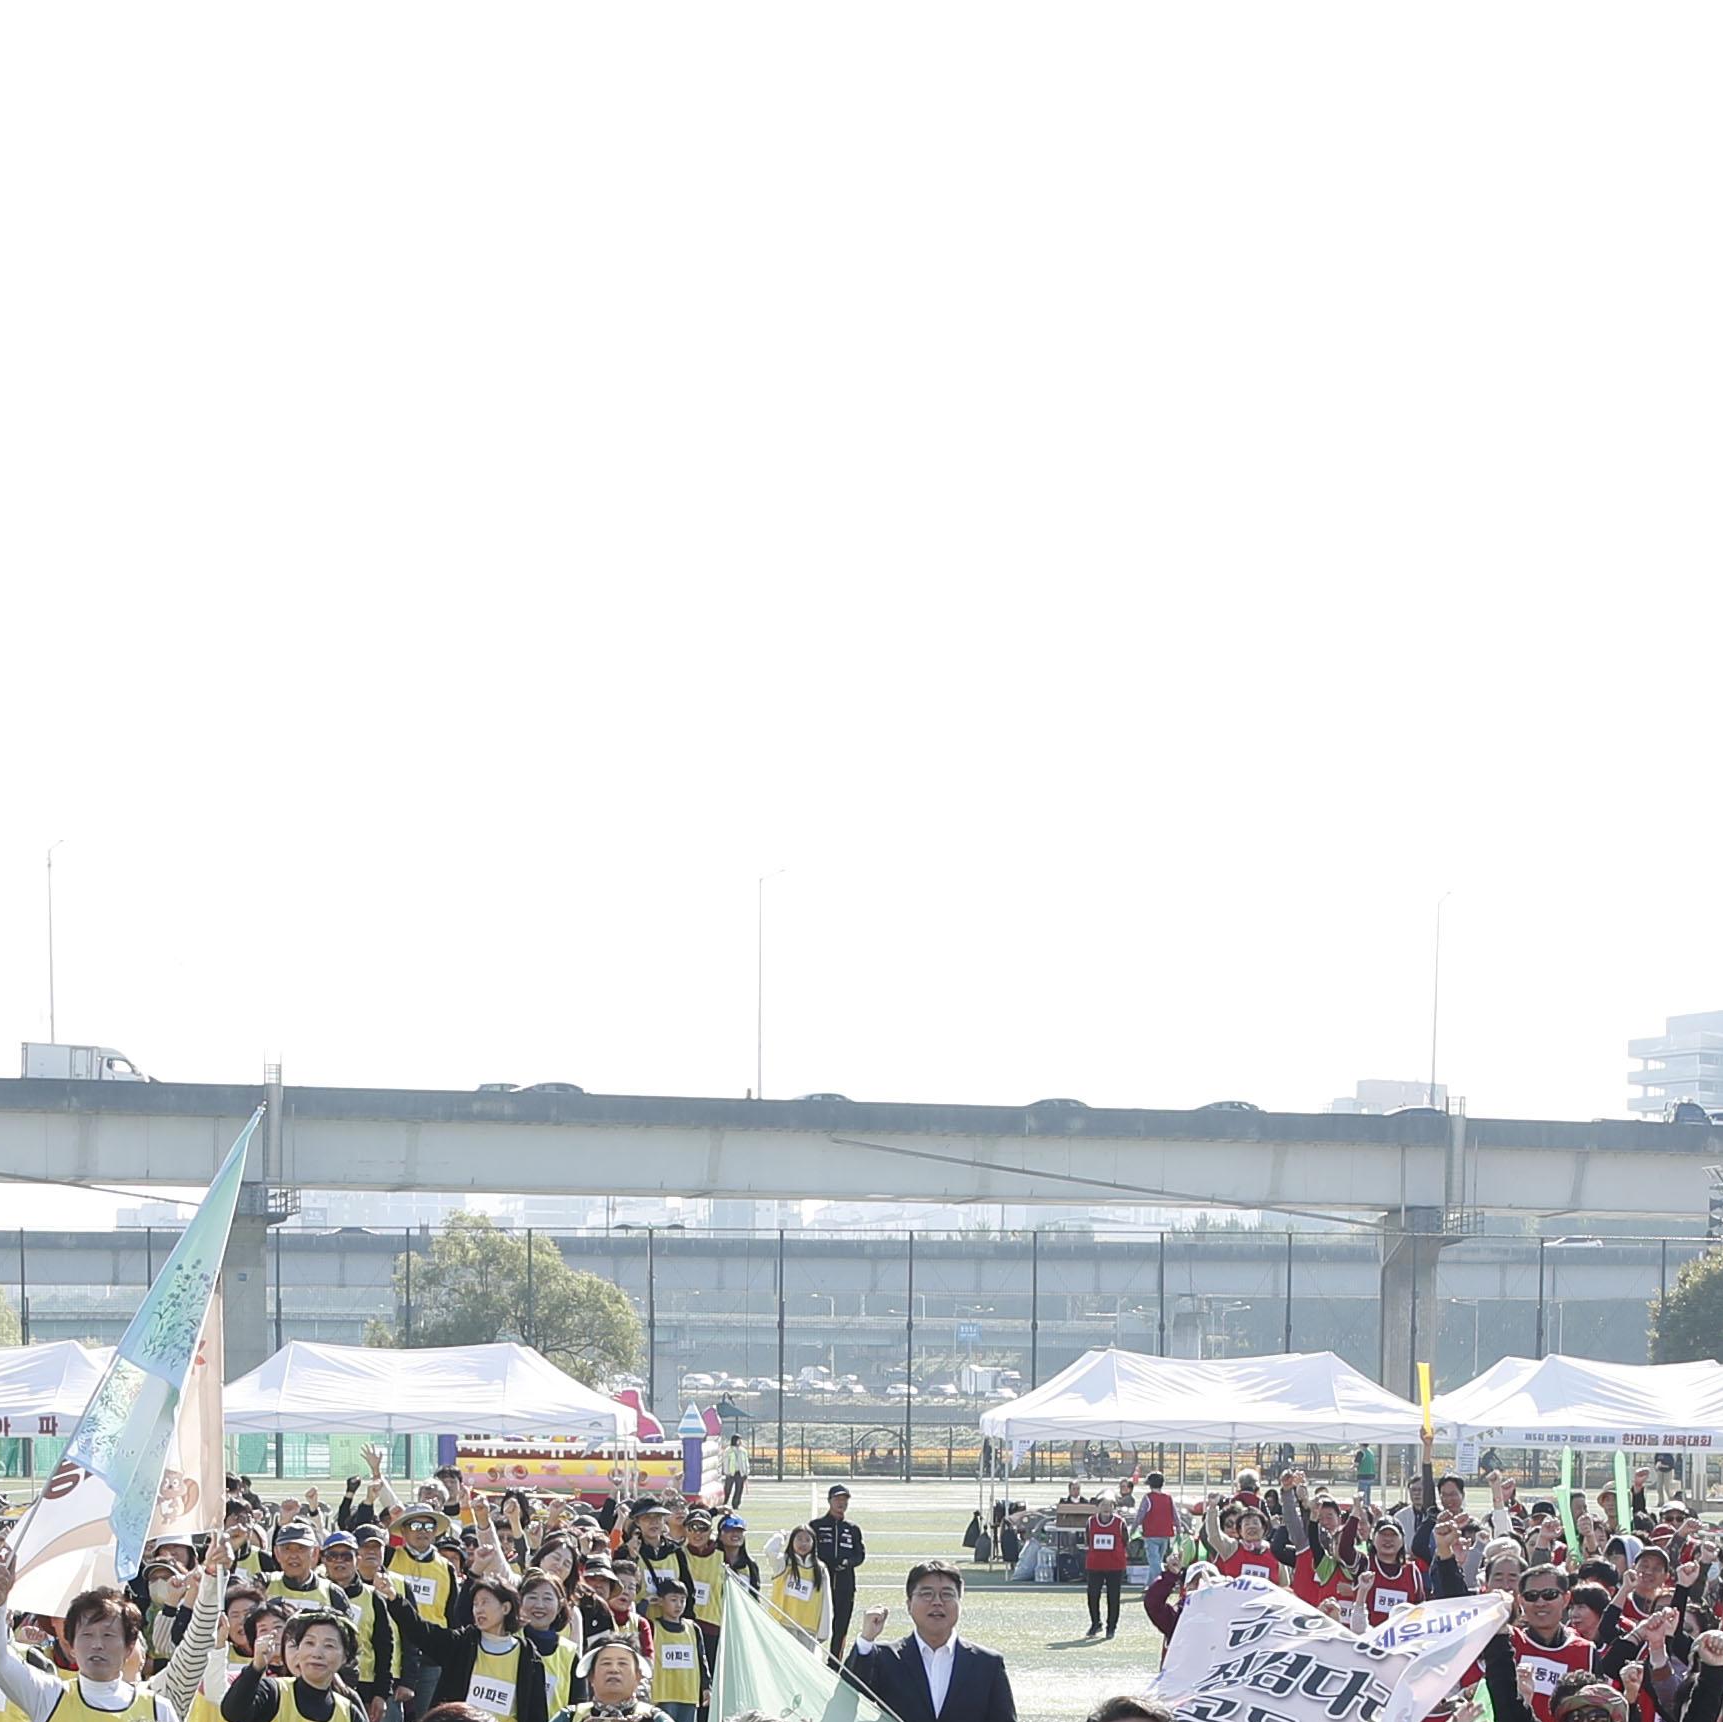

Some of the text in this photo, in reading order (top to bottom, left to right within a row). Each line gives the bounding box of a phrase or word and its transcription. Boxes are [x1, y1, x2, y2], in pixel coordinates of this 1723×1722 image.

[1621, 1433, 1658, 1446] 한마음
[1662, 1434, 1712, 1447] 체육대회
[413, 1584, 431, 1597] 파트
[666, 1650, 691, 1662] 아파트
[1534, 1666, 1560, 1685] 동체
[473, 1685, 509, 1706] 아파트
